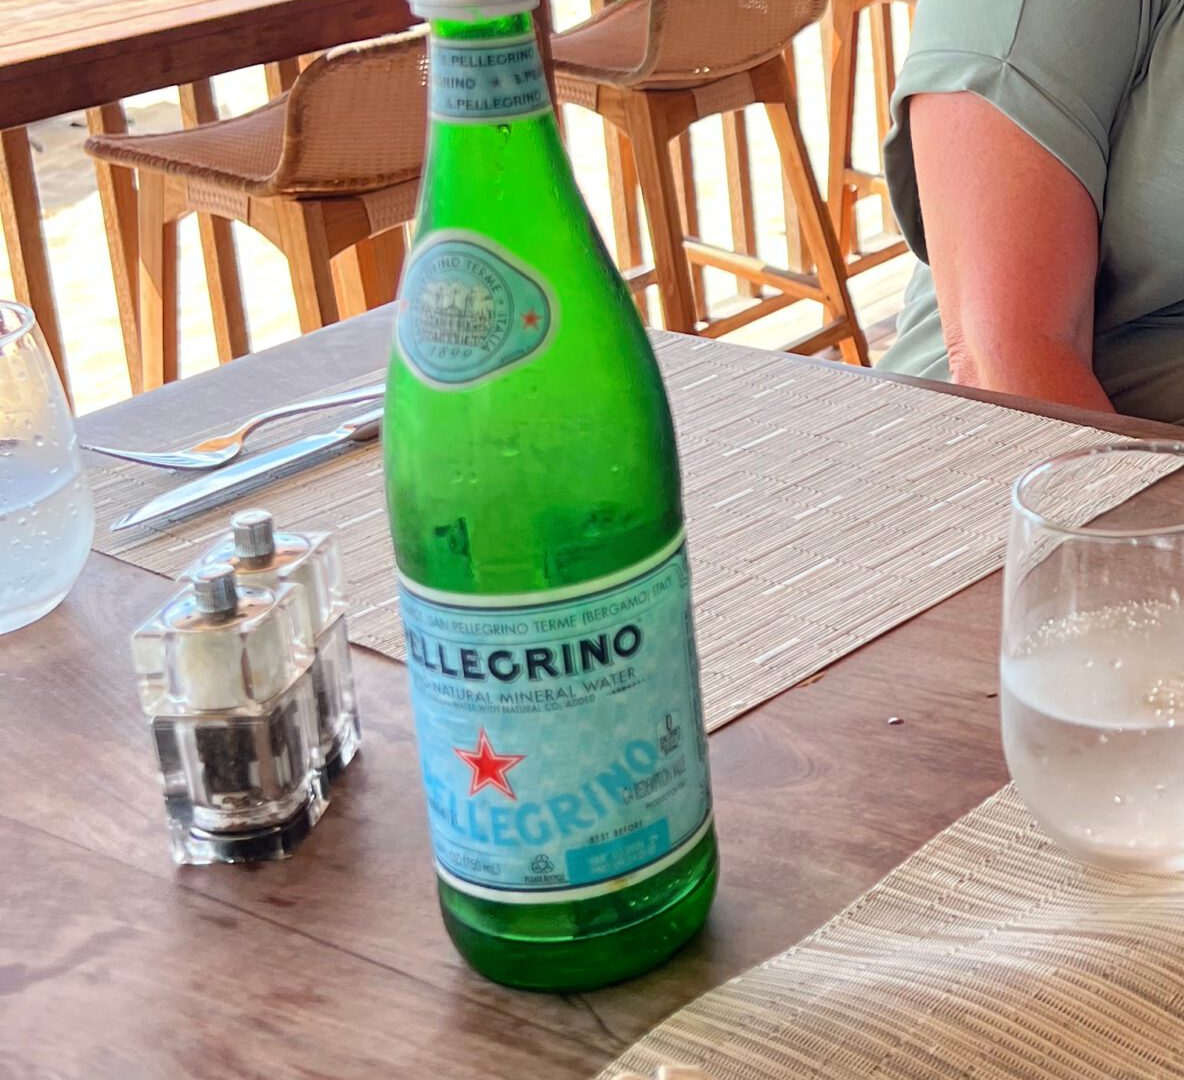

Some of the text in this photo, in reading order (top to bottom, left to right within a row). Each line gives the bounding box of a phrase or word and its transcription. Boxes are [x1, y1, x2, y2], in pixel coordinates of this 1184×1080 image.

[466, 260, 504, 294] TERME
[451, 620, 529, 636] PELLEGRINO
[534, 615, 578, 634] TERME
[652, 574, 674, 598] ITALY
[406, 623, 643, 684] ELLEGRINO
[432, 681, 493, 704] NATURAL
[500, 685, 577, 705] MINERAL
[583, 666, 637, 693] WATER
[565, 694, 596, 708] ADDED
[423, 738, 658, 847] ELLEGRINO
